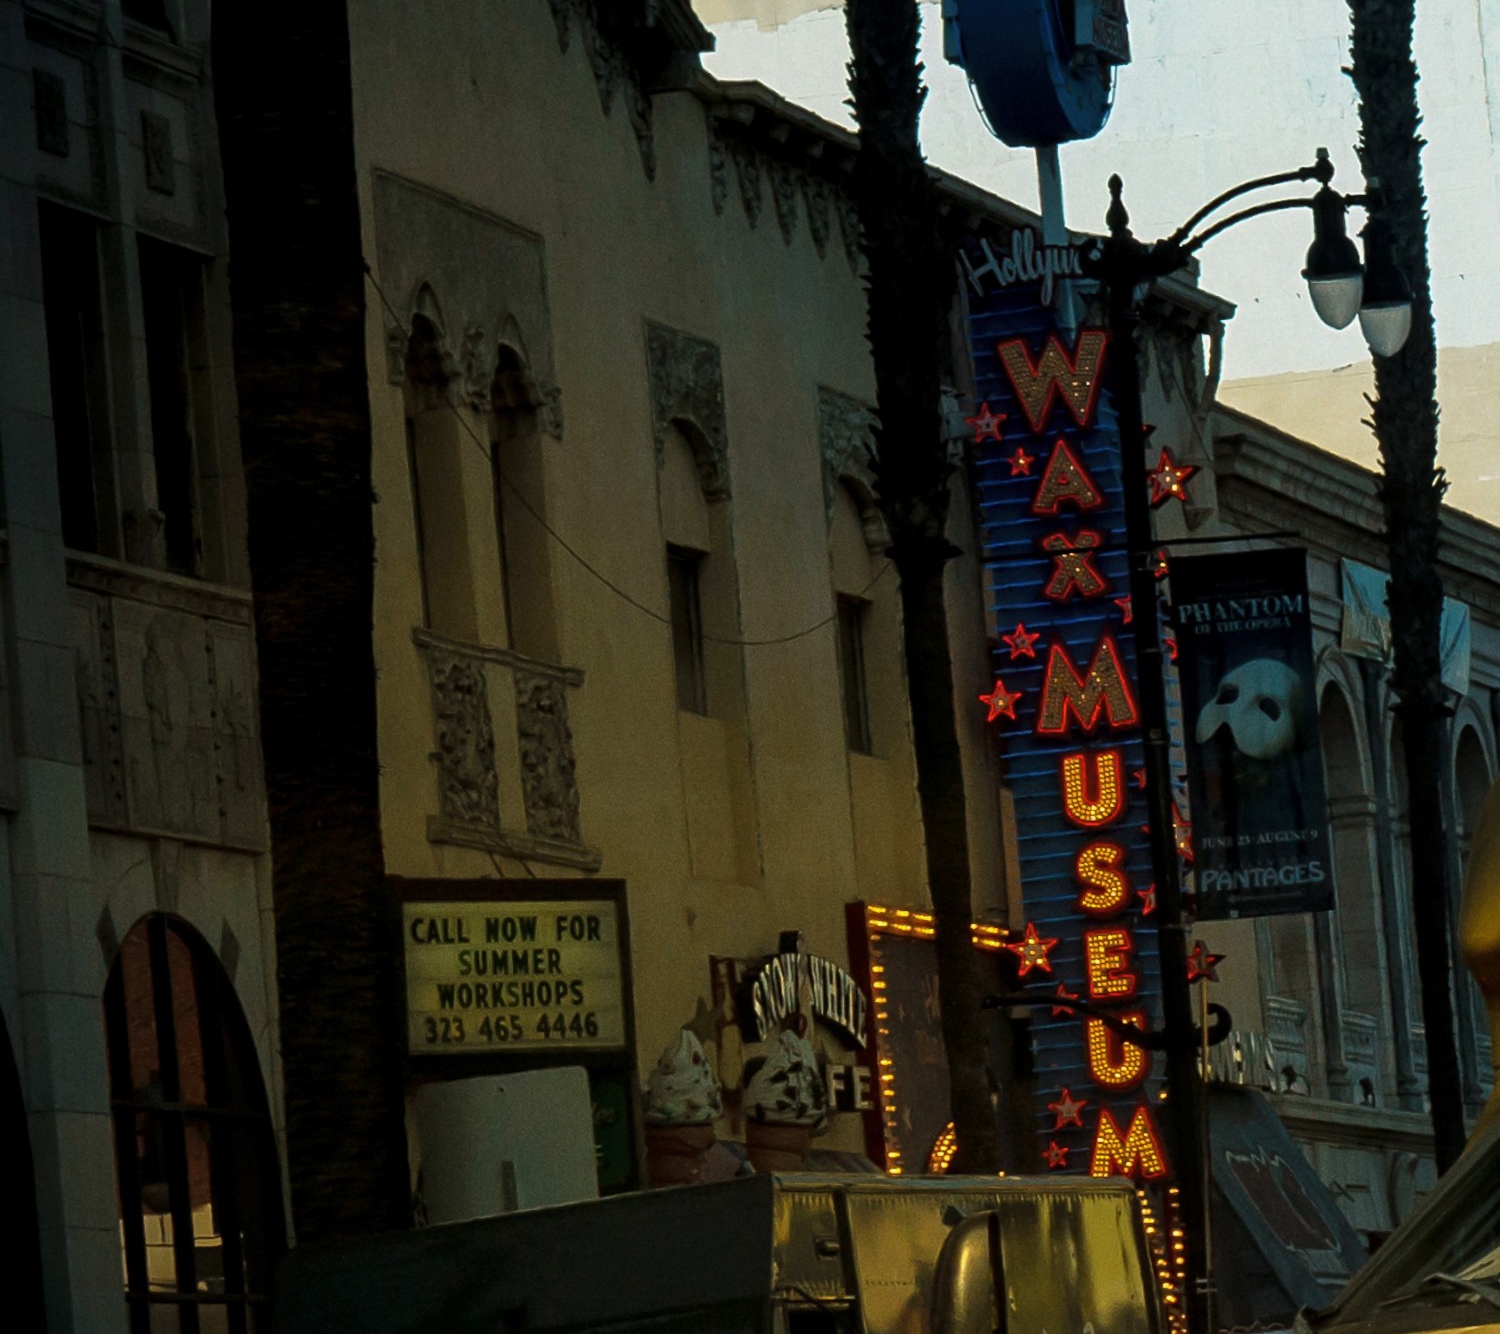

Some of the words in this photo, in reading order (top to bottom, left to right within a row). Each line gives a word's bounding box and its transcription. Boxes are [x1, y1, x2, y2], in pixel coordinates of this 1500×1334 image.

[996, 329, 1113, 602] WAX
[1177, 593, 1306, 625] PHANTOM
[1214, 619, 1241, 634] THE
[1244, 616, 1292, 632] OPERA
[1200, 860, 1327, 893] PANTAGES
[1036, 635, 1169, 1179] MUSEUM
[410, 917, 470, 944] CALL
[486, 916, 538, 943] NOW
[555, 916, 601, 942] FOR
[458, 947, 562, 976] SUMMER
[437, 979, 584, 1010] WORKSHOPS
[808, 953, 869, 1050] WHITE
[424, 1017, 466, 1044] 323
[478, 1014, 524, 1042] 465
[535, 1011, 599, 1039] 4446
